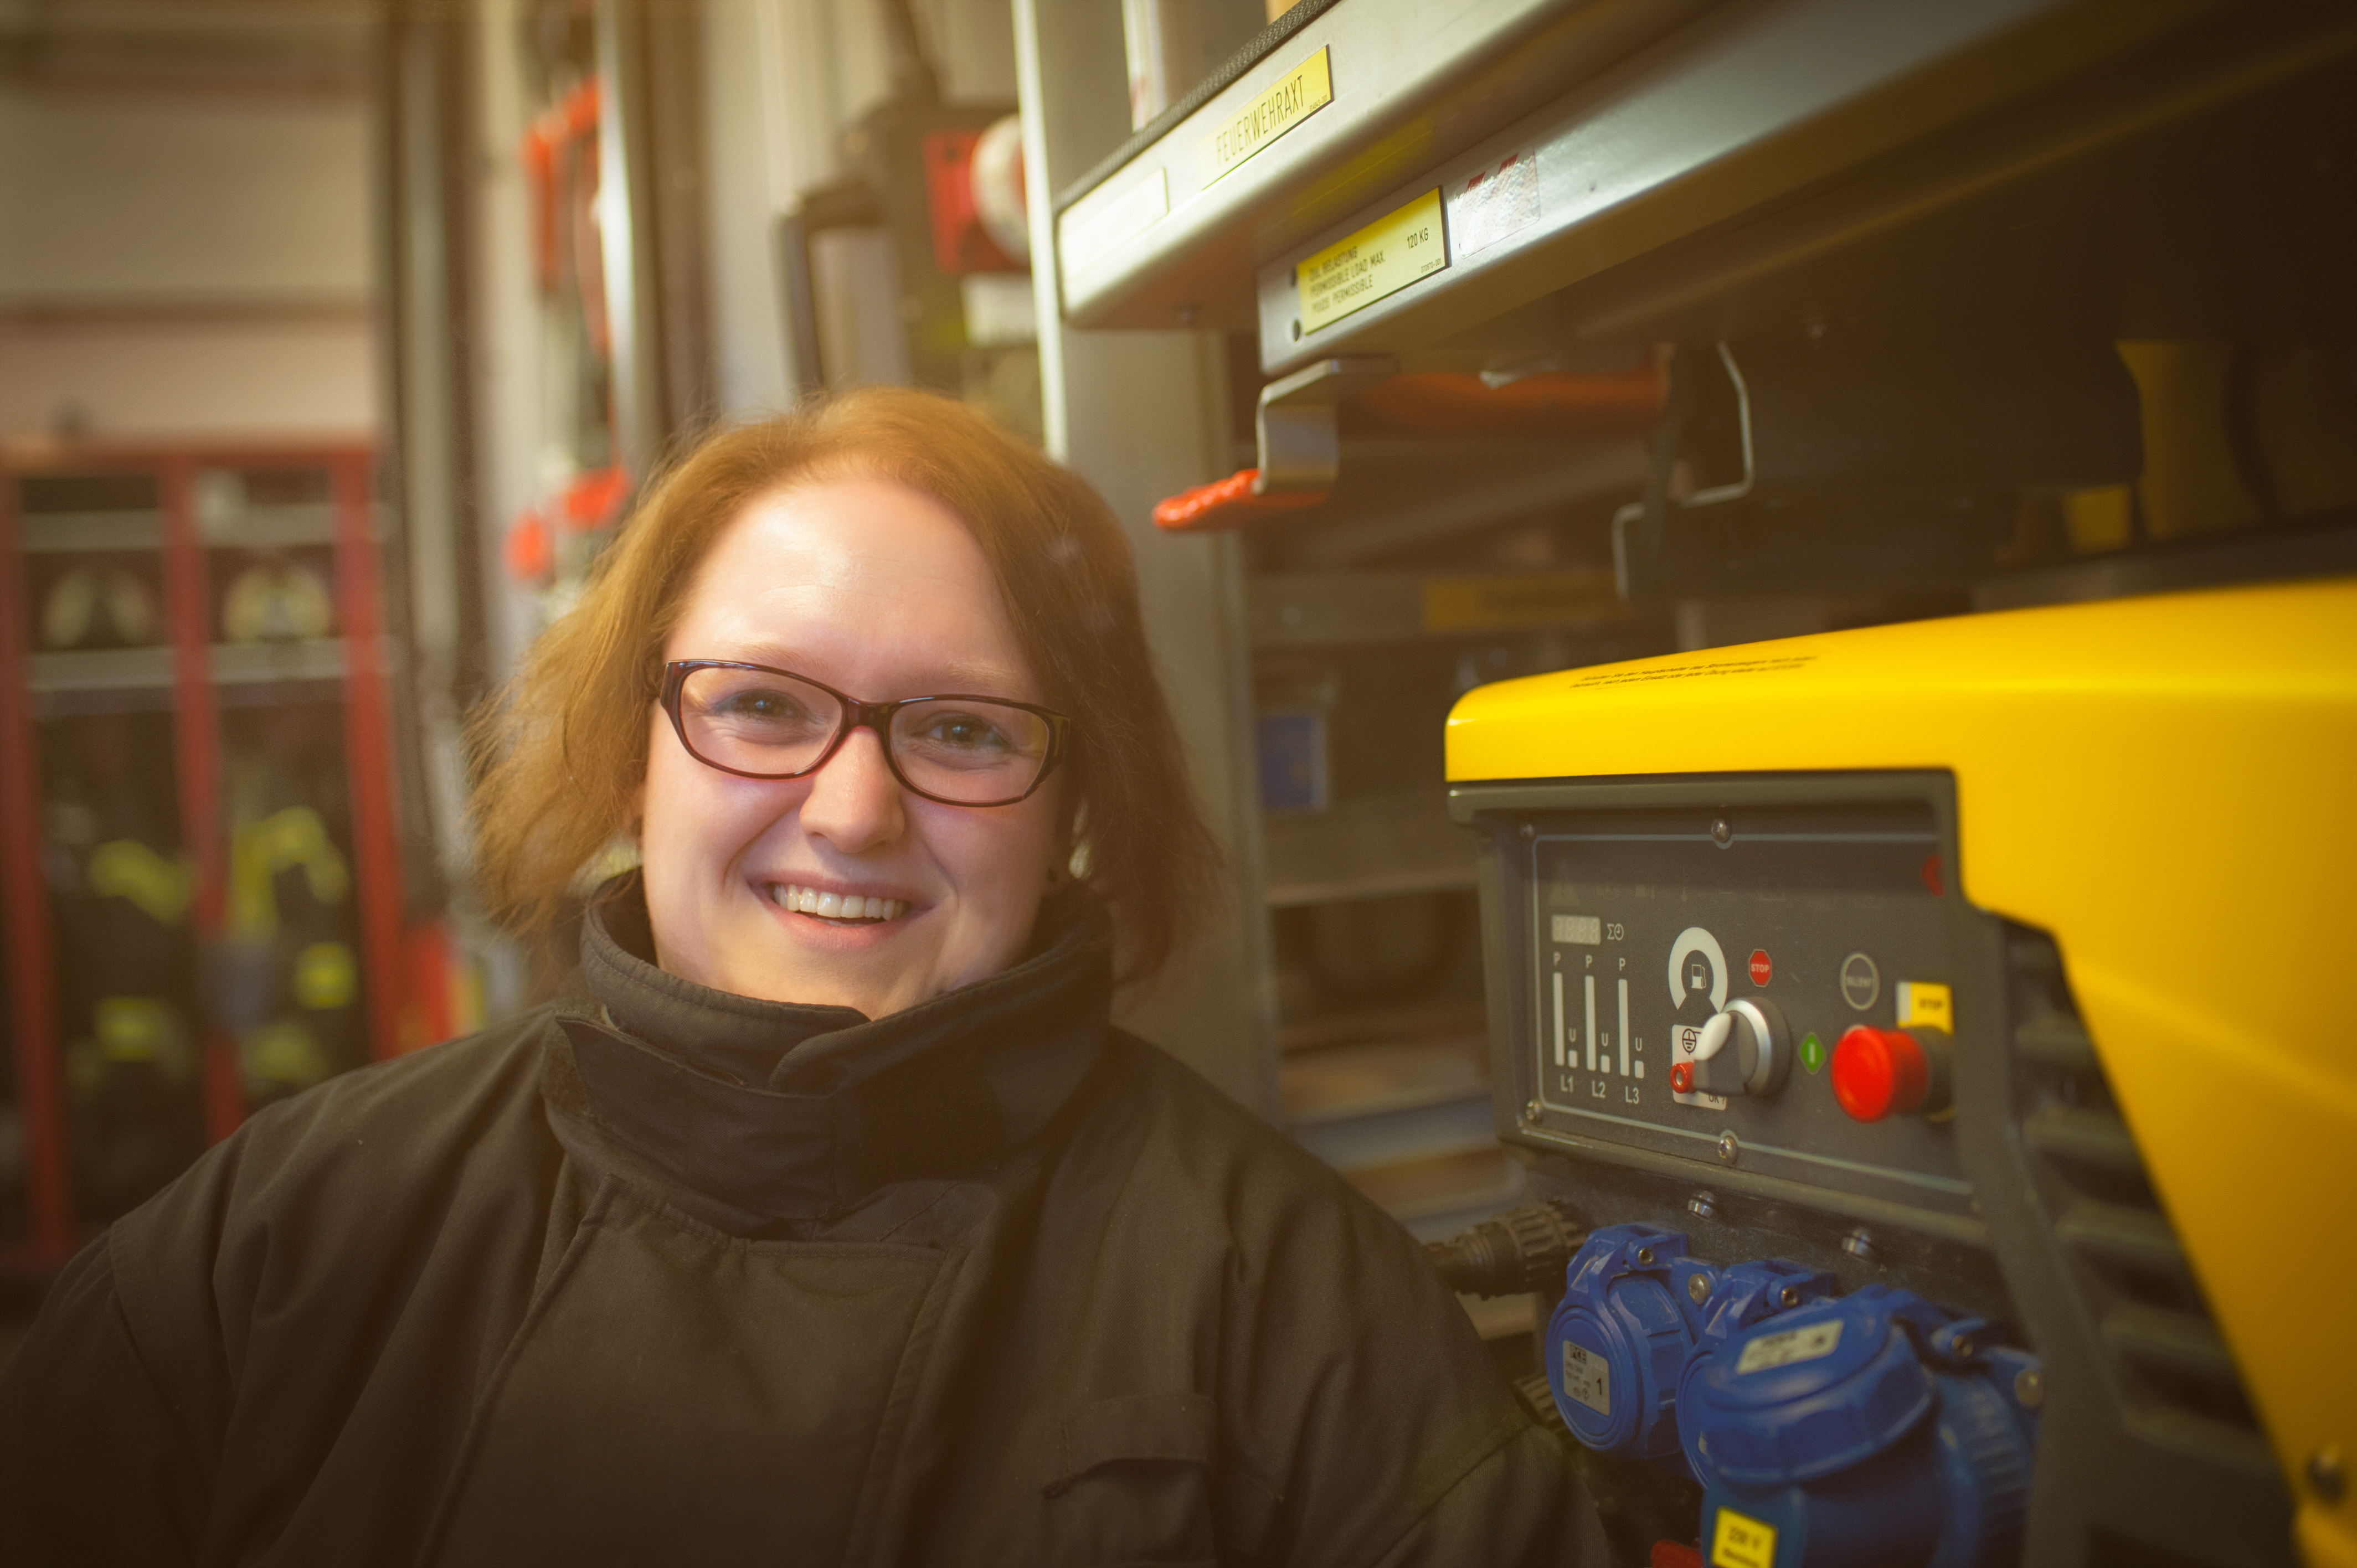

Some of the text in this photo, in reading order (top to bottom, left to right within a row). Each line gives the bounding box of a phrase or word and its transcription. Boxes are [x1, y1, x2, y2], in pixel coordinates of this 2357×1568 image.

[1216, 74, 1304, 167] FEUERWEHRAXT
[1407, 228, 1428, 249] 120 KG
[1351, 259, 1369, 278] LOAD
[1553, 952, 1561, 966] P
[1585, 954, 1593, 969] P
[1619, 957, 1626, 972] P
[1751, 963, 1770, 973] STOP
[1568, 1028, 1576, 1043] U
[1601, 1033, 1609, 1047] U
[1635, 1038, 1642, 1051] U
[1560, 1074, 1574, 1092] L1
[1592, 1080, 1606, 1098] L2
[1625, 1086, 1640, 1105] L3
[1596, 1377, 1602, 1396] 1
